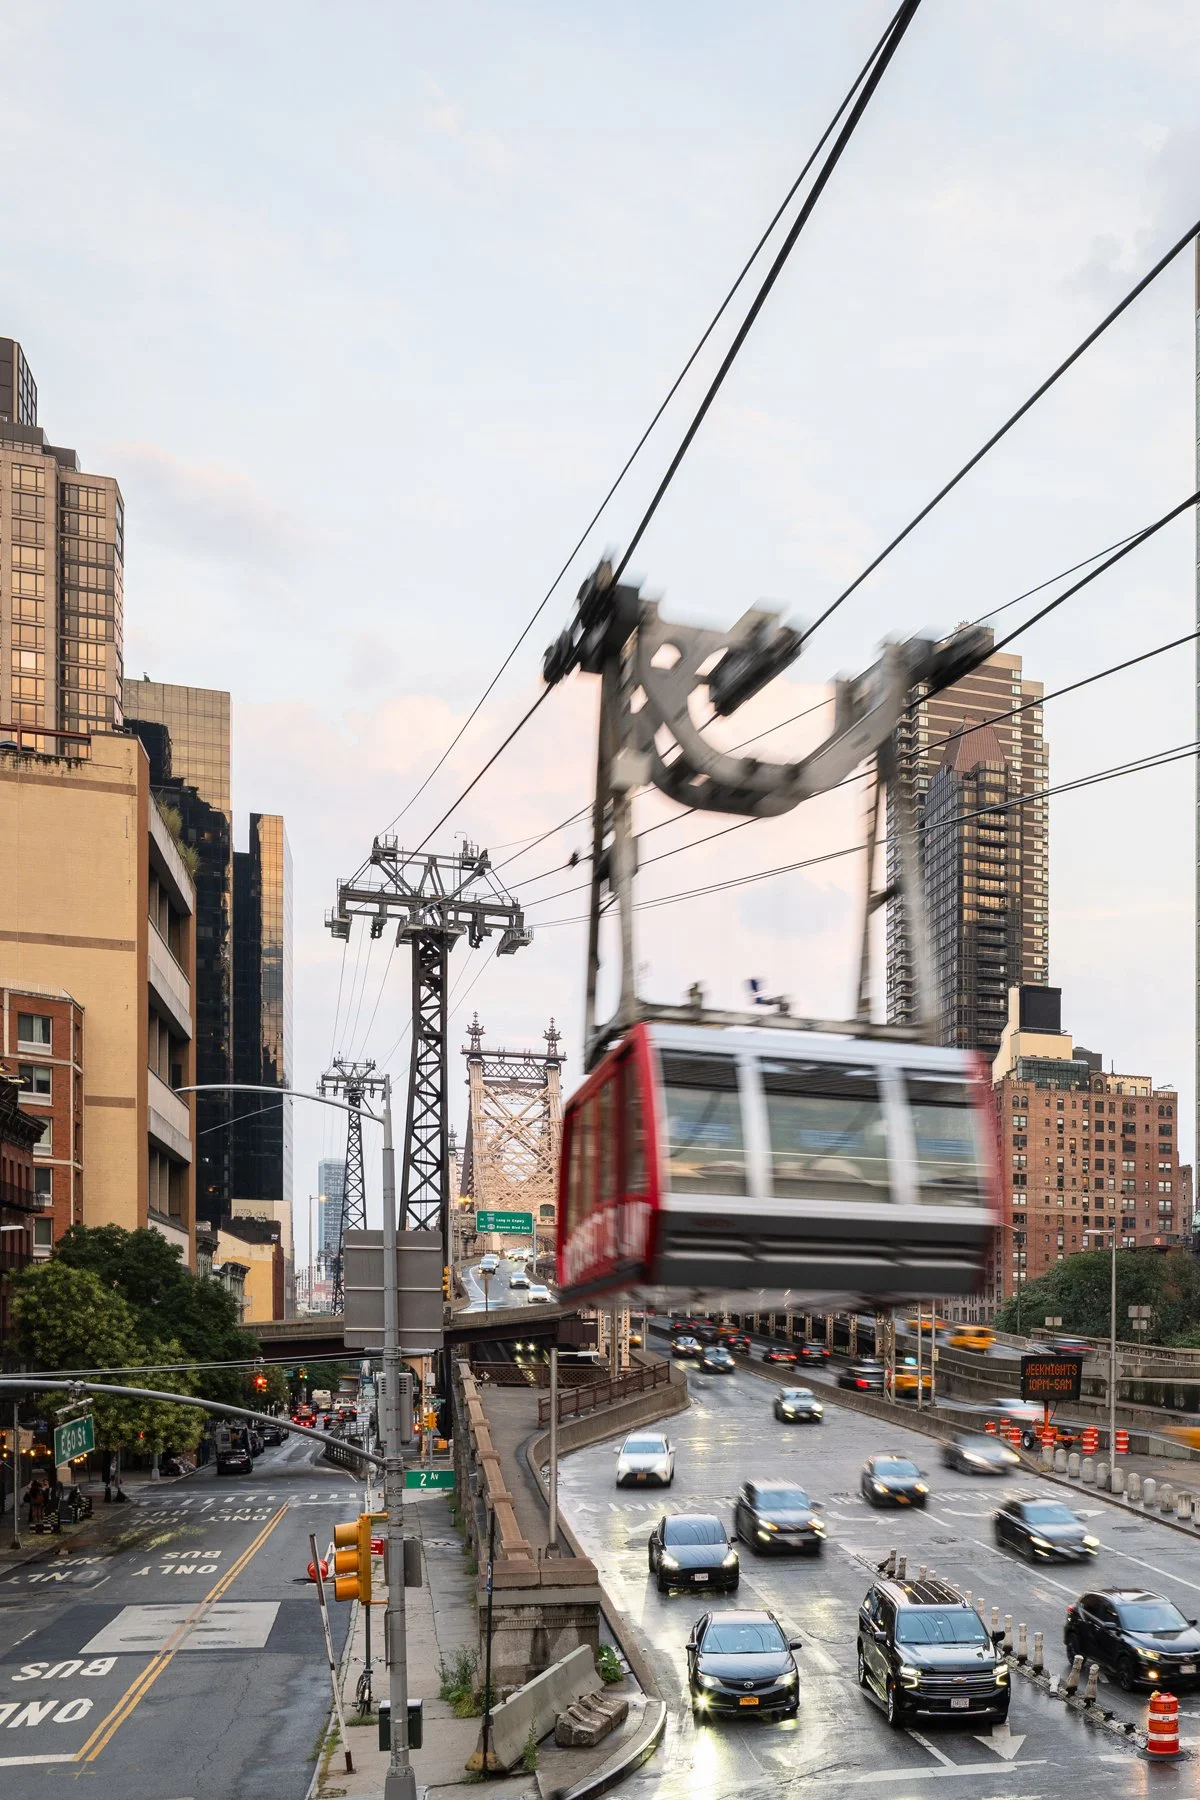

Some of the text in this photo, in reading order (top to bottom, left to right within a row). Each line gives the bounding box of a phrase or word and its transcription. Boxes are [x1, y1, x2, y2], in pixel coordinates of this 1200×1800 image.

[67, 1430, 75, 1452] 60
[78, 1426, 86, 1447] St
[420, 1472, 439, 1486] 2 Av
[48, 1556, 114, 1567] BUS
[161, 1550, 222, 1559] BUS
[3, 1570, 99, 1584] ONLY
[131, 1564, 218, 1576] ONLY
[12, 1656, 119, 1681] BUS
